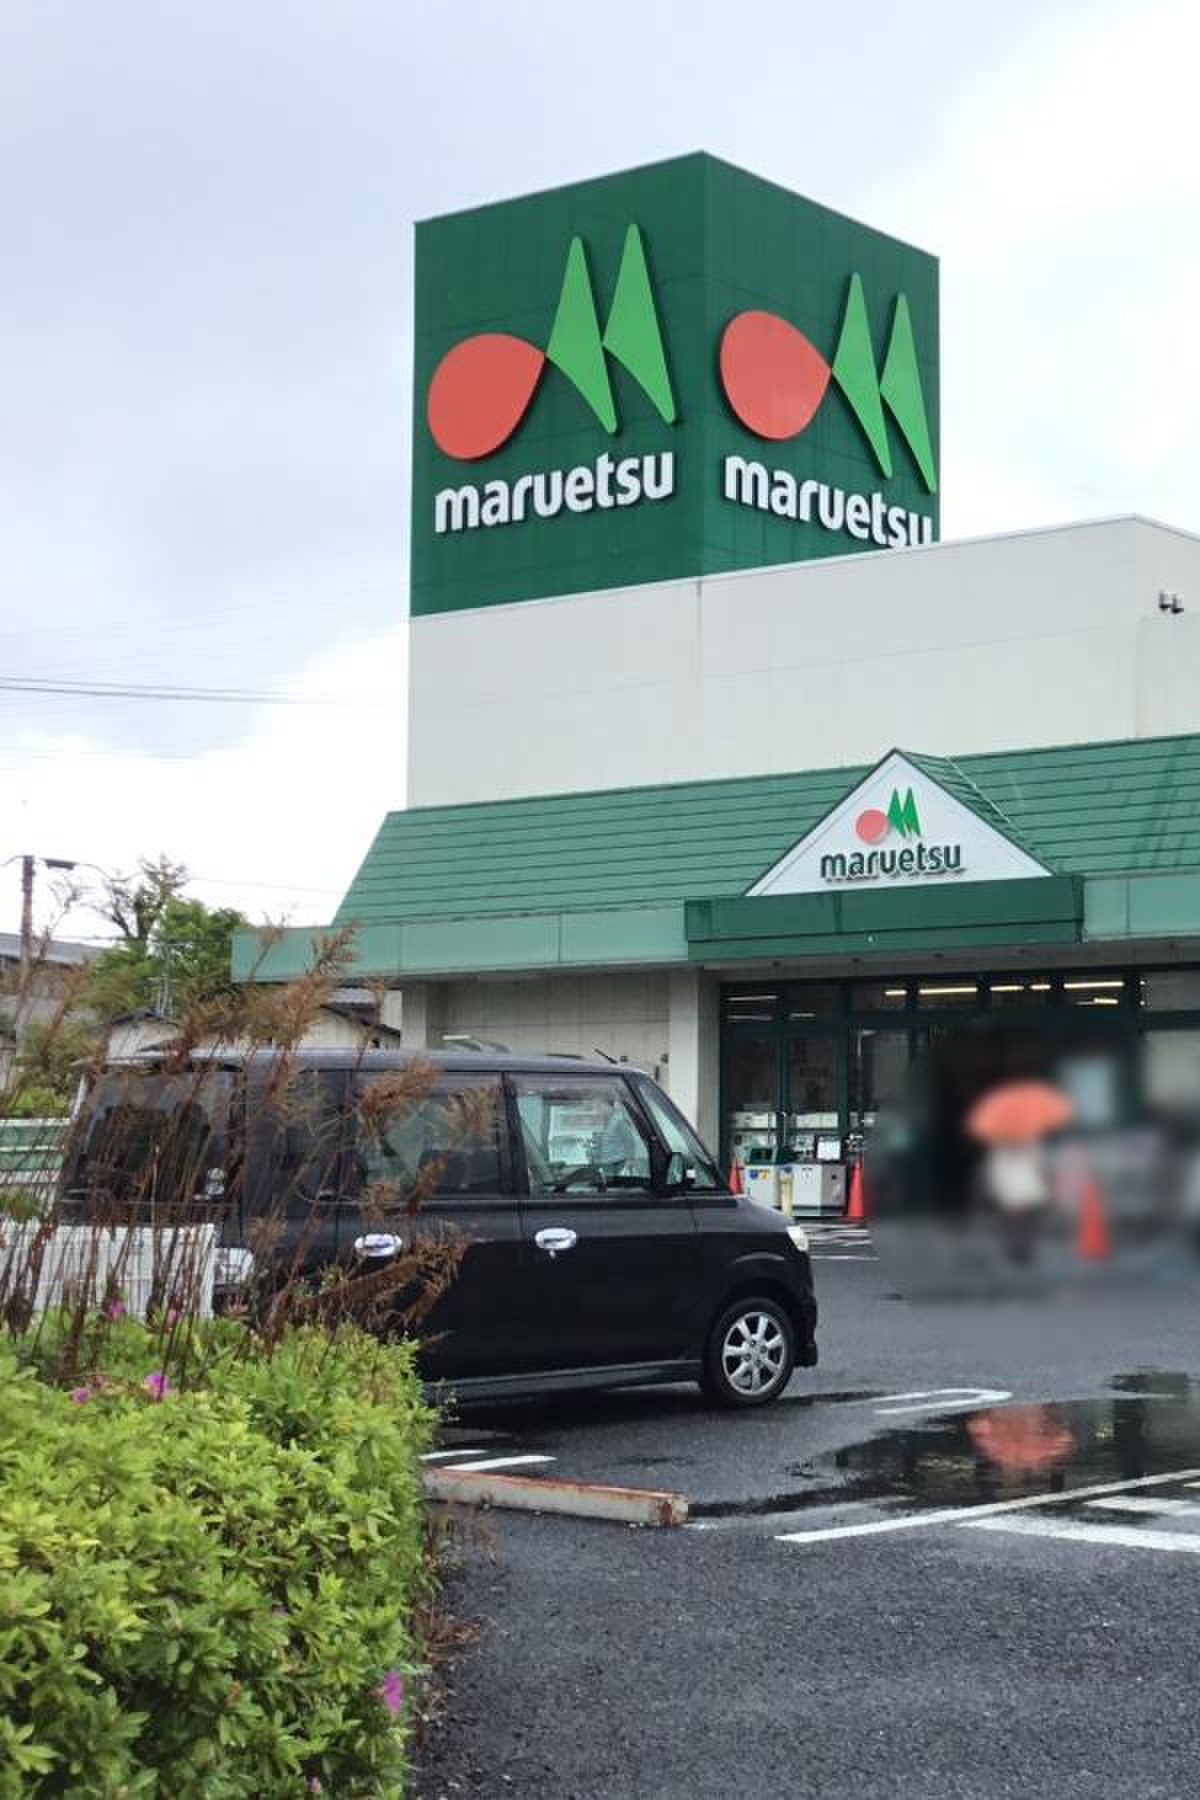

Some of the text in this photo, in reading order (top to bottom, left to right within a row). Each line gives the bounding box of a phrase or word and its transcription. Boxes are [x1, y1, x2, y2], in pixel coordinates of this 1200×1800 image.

[434, 452, 674, 534] maruetsu
[724, 455, 933, 547] maruetsu
[820, 842, 961, 878] maruetsu
